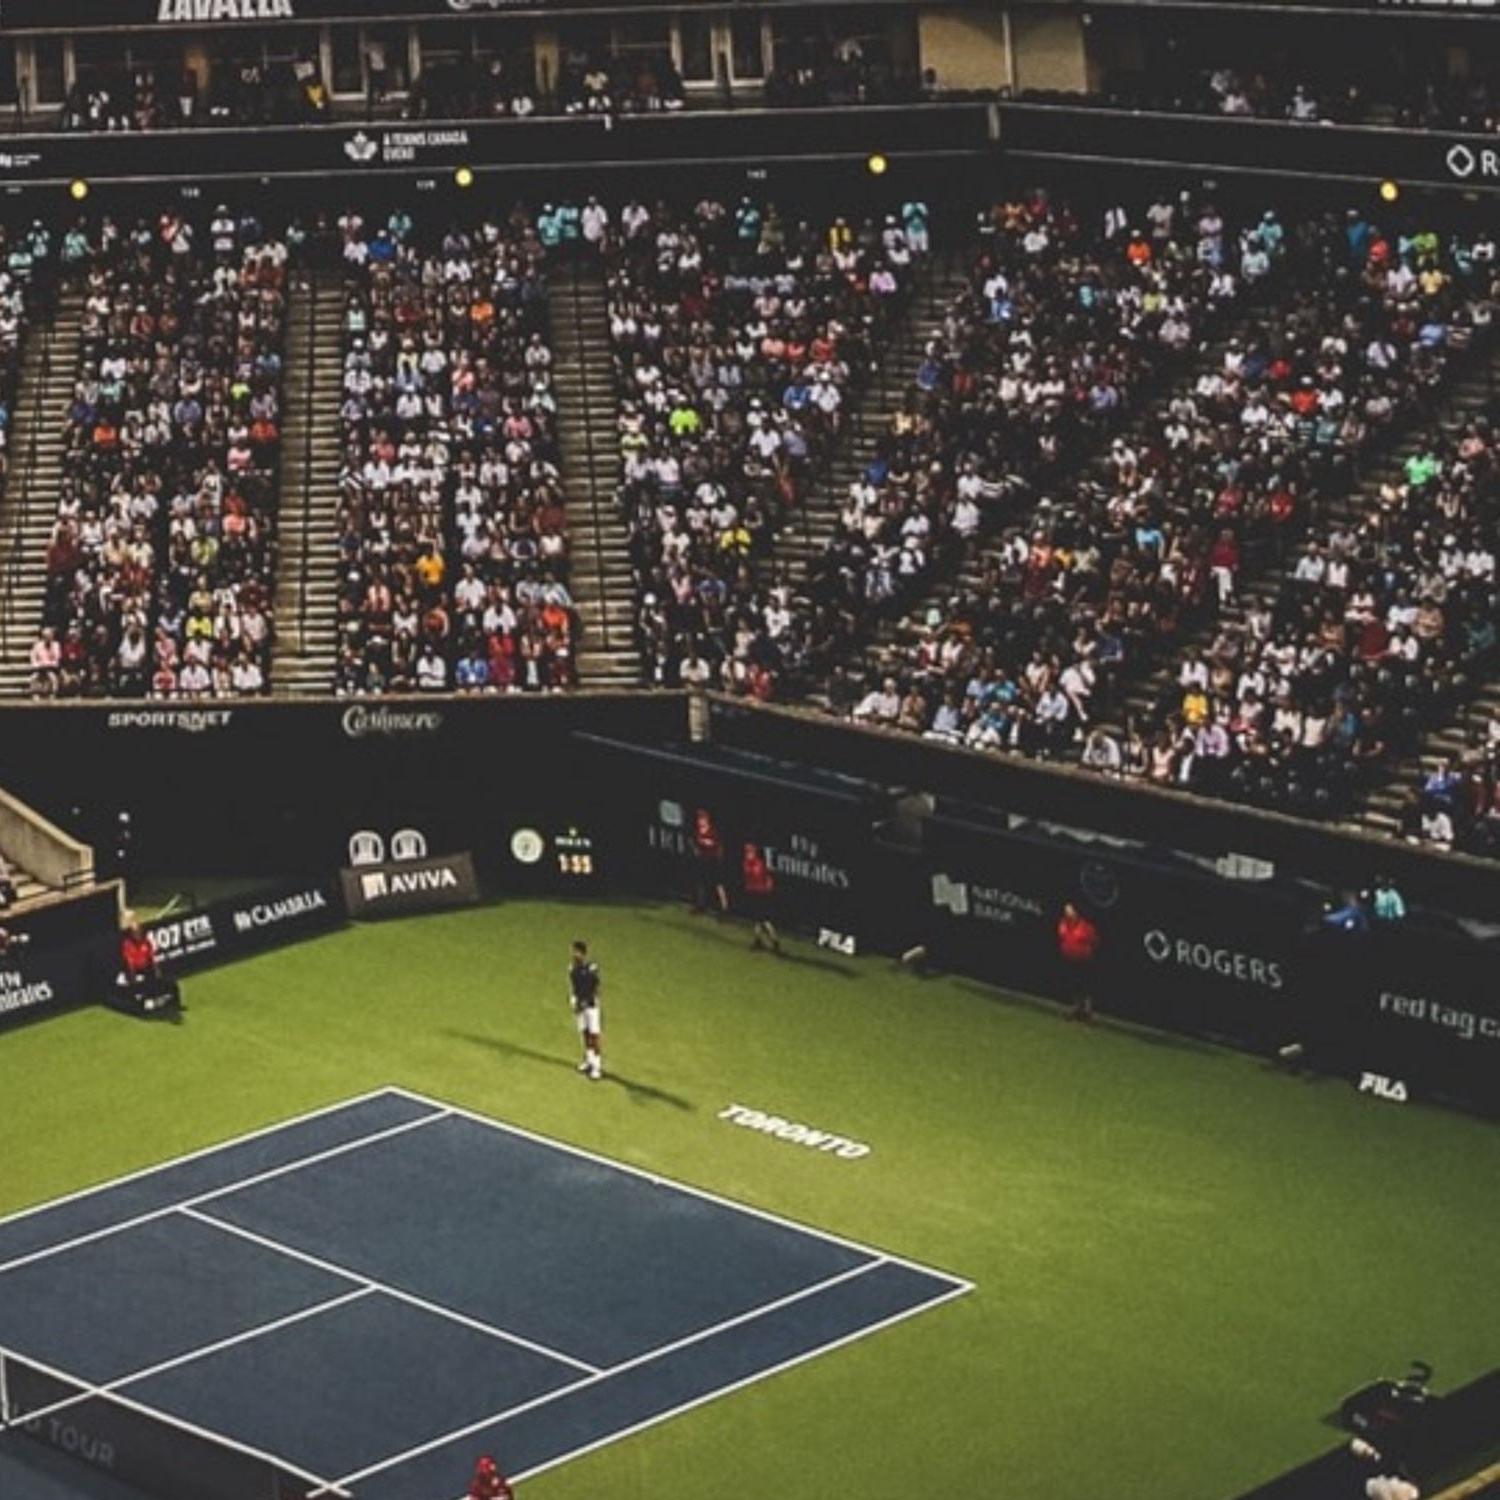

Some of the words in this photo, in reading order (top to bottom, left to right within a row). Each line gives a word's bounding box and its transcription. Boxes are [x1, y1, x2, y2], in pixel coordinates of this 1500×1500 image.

[108, 710, 233, 730] SPORTSNET
[391, 868, 457, 894] AVIVA
[252, 889, 326, 926] CAMBRIA
[818, 927, 855, 955] FILA
[1176, 940, 1283, 989] ROGERS
[1380, 992, 1426, 1018] red
[1430, 1002, 1474, 1039] tag
[1359, 1072, 1407, 1101] FILA
[717, 1103, 871, 1158] TORONTO
[49, 1416, 116, 1469] TOUR
